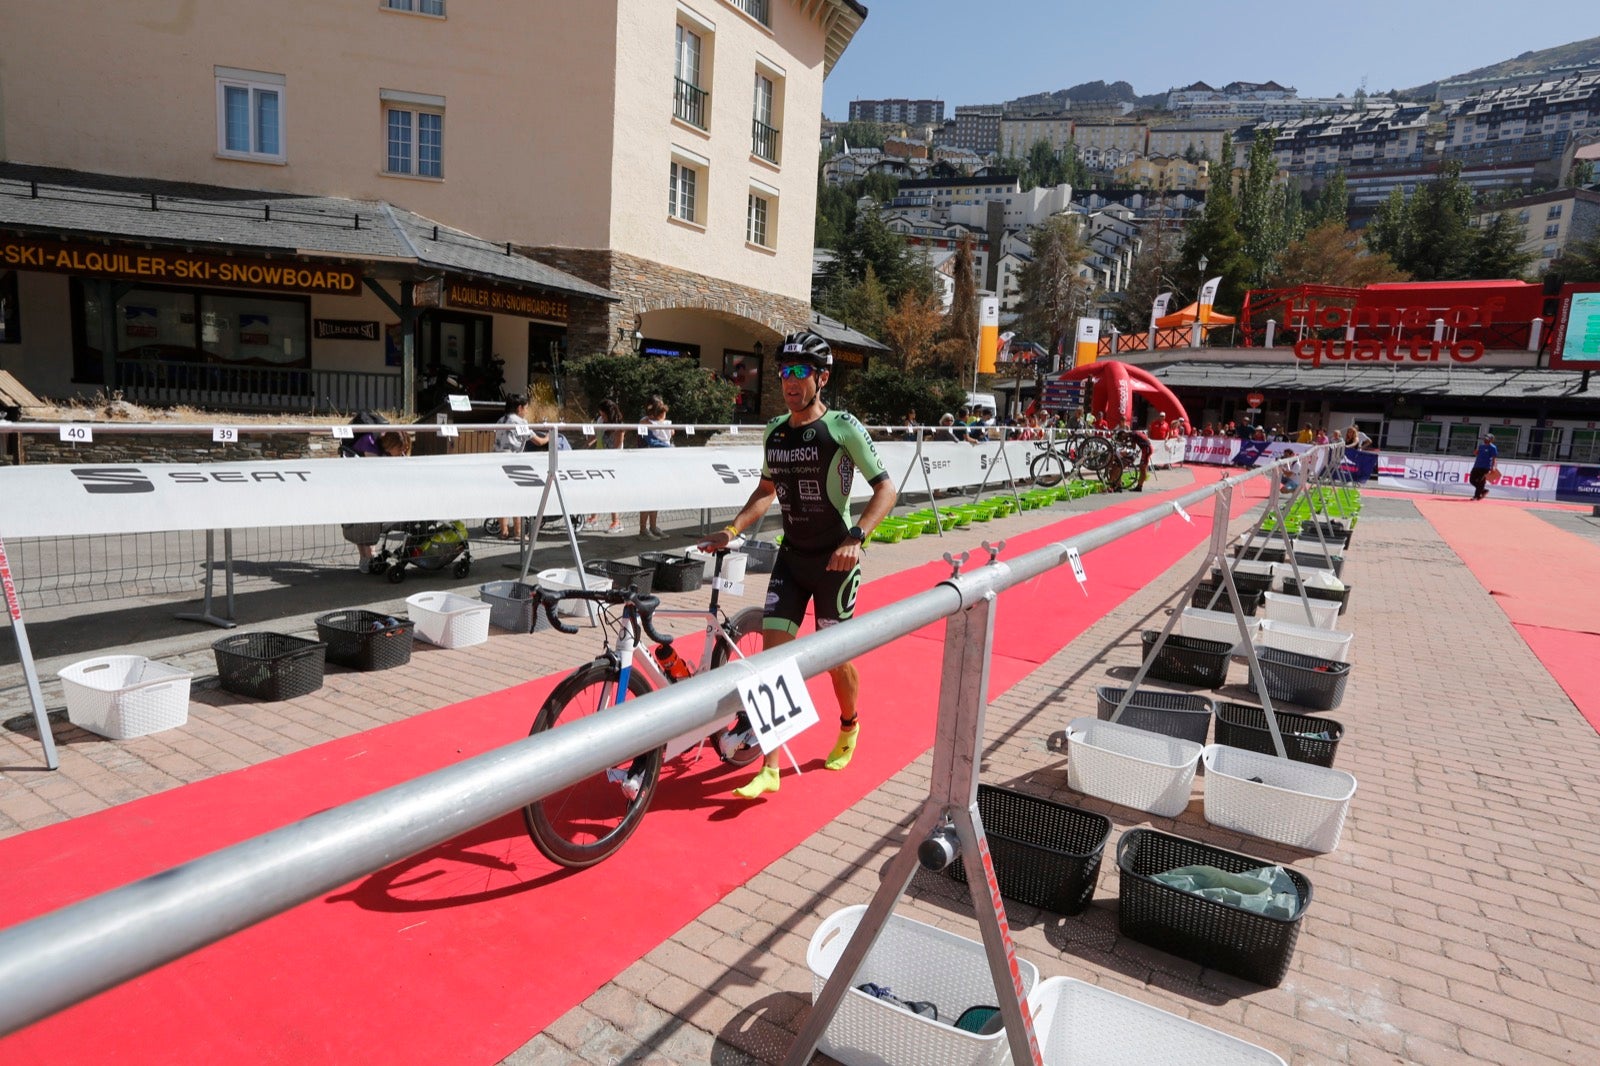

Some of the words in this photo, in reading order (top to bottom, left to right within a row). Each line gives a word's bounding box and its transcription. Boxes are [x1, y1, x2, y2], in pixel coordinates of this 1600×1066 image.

[451, 287, 489, 307] ALQUILER
[1283, 299, 1430, 329] Home
[1448, 295, 1506, 328] of
[361, 323, 374, 339] SKI
[1293, 335, 1485, 368] quattro
[67, 428, 85, 440] 40
[219, 429, 233, 439] 39
[767, 447, 819, 463] WYMMERSCH
[1193, 446, 1231, 456] nevada
[931, 459, 951, 470] SEAT
[168, 471, 311, 483] SEAT
[738, 469, 763, 477] SE
[1409, 467, 1460, 484] sierra
[723, 581, 733, 590] 87
[747, 674, 802, 734] 121
